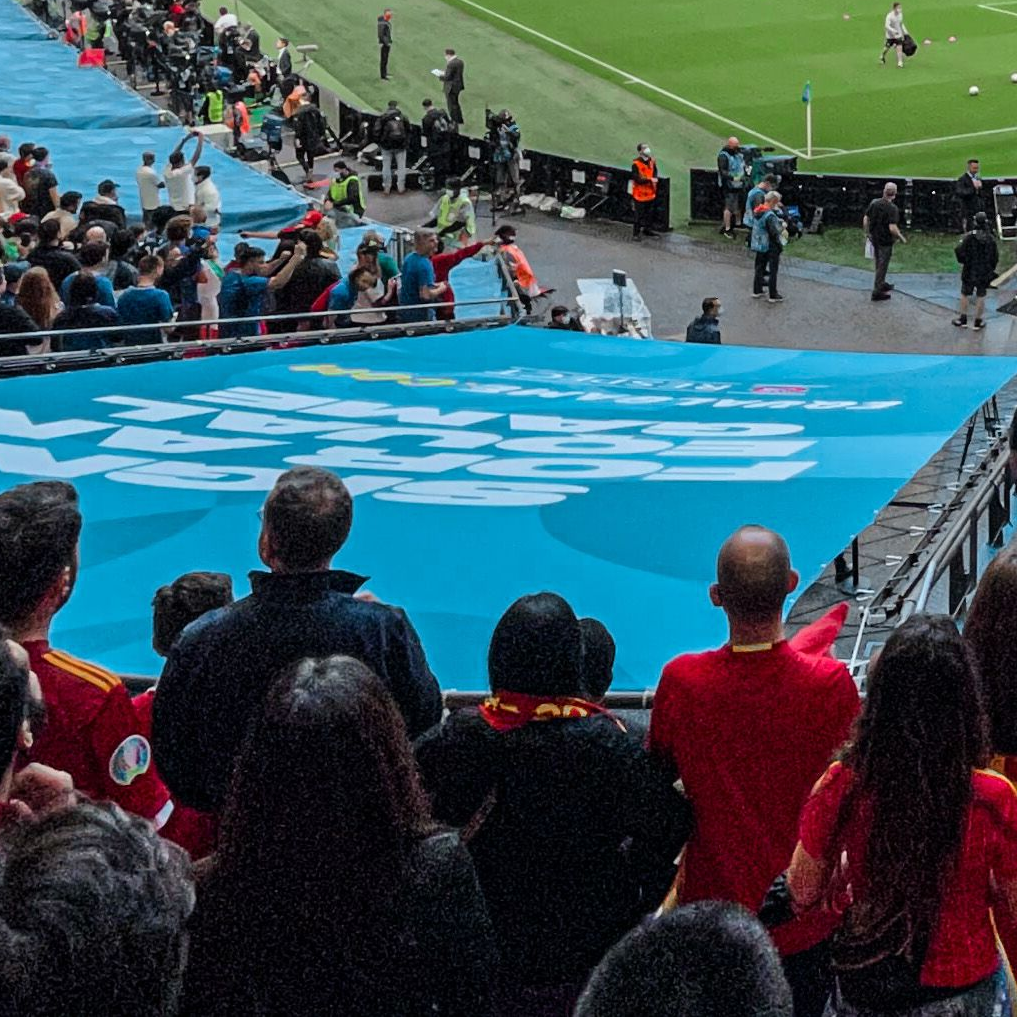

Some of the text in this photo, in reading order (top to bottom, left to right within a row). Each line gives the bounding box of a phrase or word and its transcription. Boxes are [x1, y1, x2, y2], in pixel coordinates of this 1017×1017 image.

[92, 394, 818, 458] EQUAL
[182, 386, 805, 437] GAME
[282, 445, 818, 481] FOR
